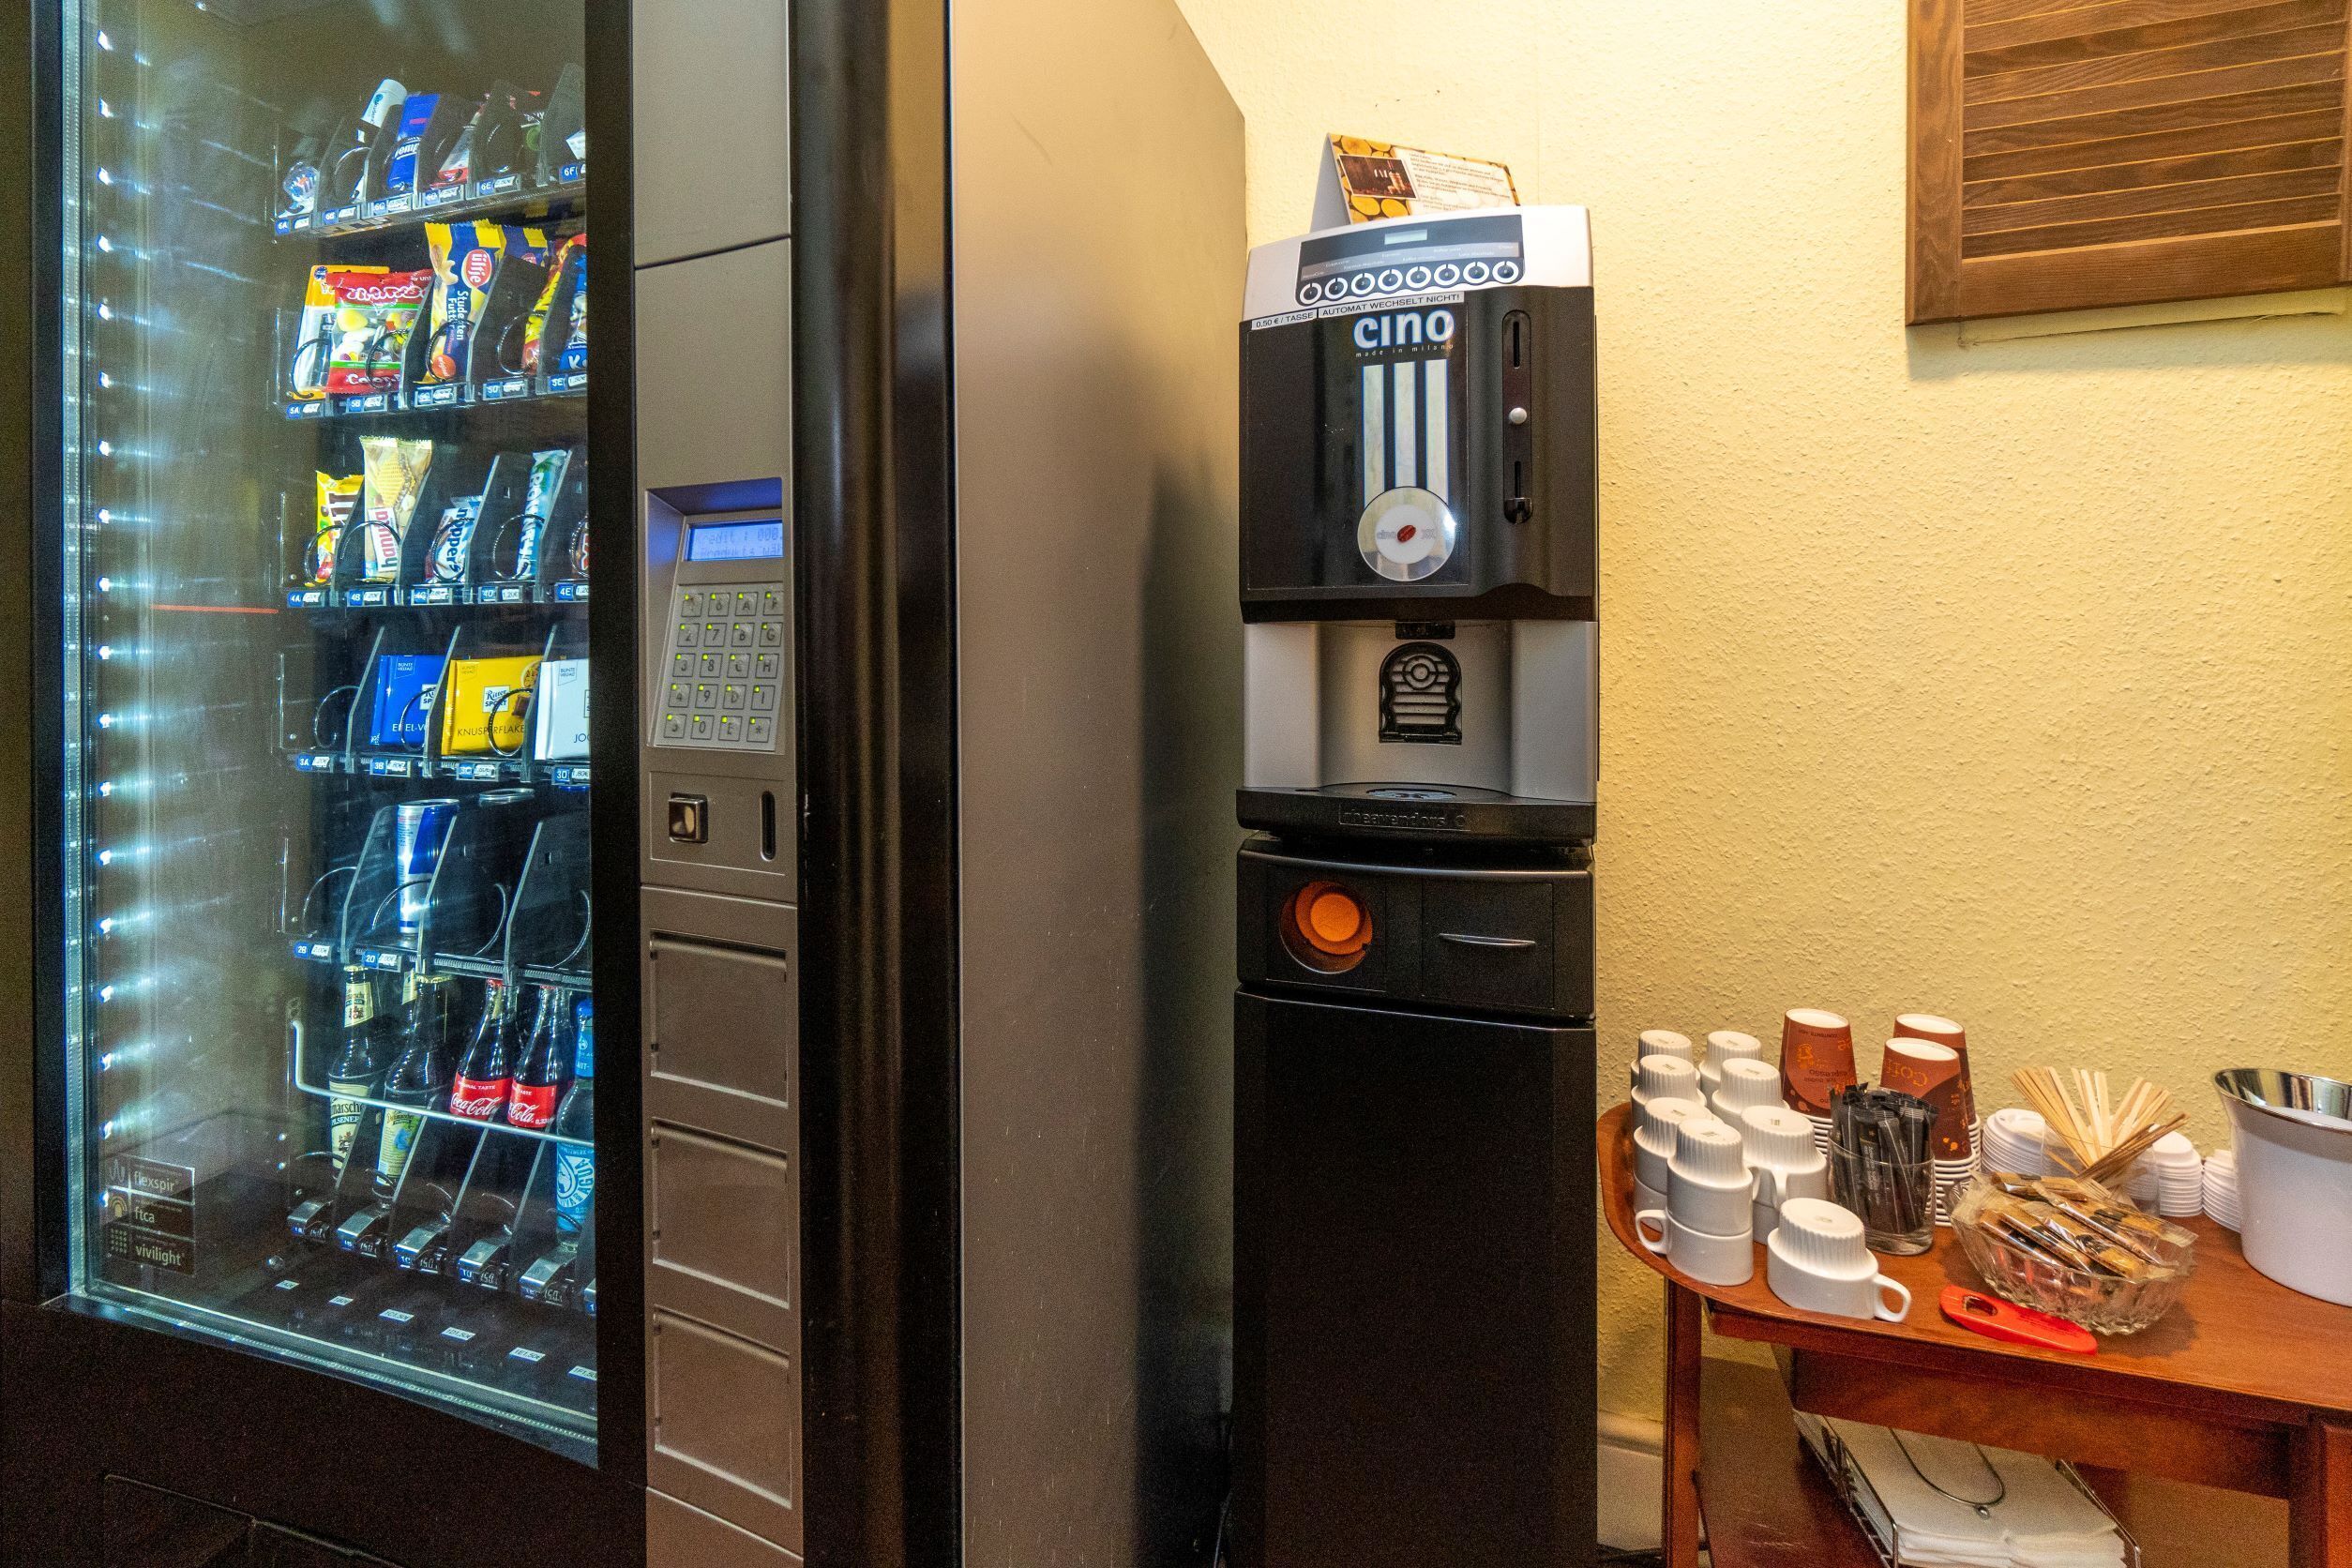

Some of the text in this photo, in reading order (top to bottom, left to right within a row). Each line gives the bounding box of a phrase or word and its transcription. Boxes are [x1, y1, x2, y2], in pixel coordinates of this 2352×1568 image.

[1322, 294, 1460, 316] AUTOMAT WECHSELT NICHT!
[1256, 318, 1273, 328] 0,50
[1286, 311, 1314, 323] TASSE
[1353, 309, 1455, 350] cino
[1355, 350, 1384, 358] made
[1411, 343, 1455, 353] milano
[560, 587, 571, 596] 4E
[742, 600, 750, 611] A
[713, 628, 720, 641] 7
[681, 659, 688, 671] 3
[707, 659, 715, 672] 8
[762, 661, 772, 672] H
[703, 690, 711, 702] 9
[135, 1206, 156, 1223] ftca
[135, 1244, 182, 1266] vivilight
